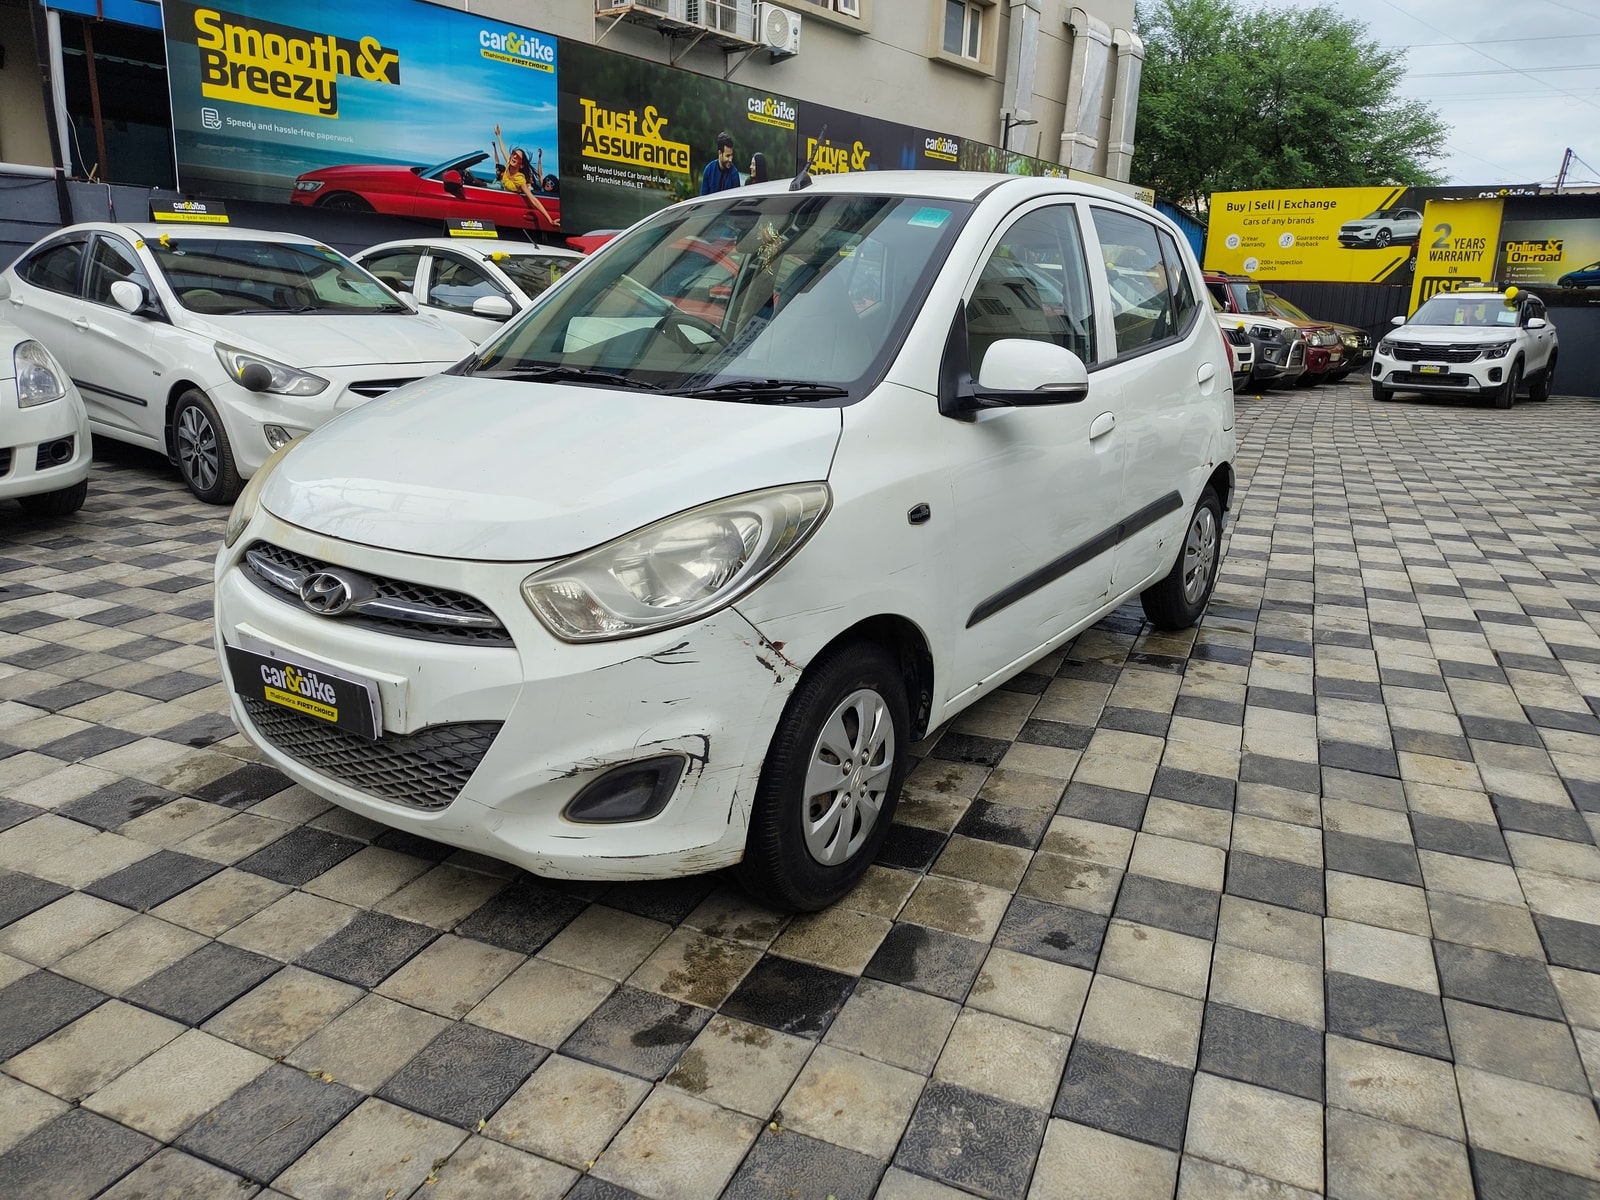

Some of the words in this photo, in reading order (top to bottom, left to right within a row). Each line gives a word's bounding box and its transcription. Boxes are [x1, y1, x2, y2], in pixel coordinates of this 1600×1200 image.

[194, 9, 351, 76] Smooth
[356, 36, 399, 84] &
[480, 30, 554, 62] car&bike
[512, 57, 528, 66] FIRST
[528, 62, 548, 71] CHOICE
[201, 49, 337, 115] Breezy
[580, 98, 637, 134] Trust
[642, 105, 668, 140] &
[748, 98, 795, 120] car&bike
[226, 117, 256, 130] Speedy
[257, 122, 273, 132] and
[274, 124, 315, 138] hassle-free
[316, 133, 354, 144] paperwork
[582, 126, 688, 169] Assurance
[807, 137, 848, 164] Drive
[851, 141, 871, 170] &
[925, 137, 957, 155] car&bike
[582, 163, 597, 173] Most
[597, 166, 612, 175] loved
[613, 169, 626, 177] Used
[627, 171, 636, 179] Car
[636, 173, 652, 182] brand
[658, 176, 671, 184] India
[586, 173, 594, 183] By
[595, 175, 620, 186] Franchise
[1226, 202, 1246, 212] Buy
[1254, 200, 1275, 210] Sell
[1284, 199, 1337, 210] Exchange
[1261, 217, 1271, 225] of
[1272, 218, 1286, 226] any
[1431, 223, 1452, 249] 2
[1454, 238, 1486, 249] YEARS
[1506, 241, 1542, 252] Online
[1545, 237, 1563, 252] &
[1429, 250, 1484, 262] WARRANTY
[1511, 251, 1562, 262] On-road
[1448, 266, 1458, 274] ON
[260, 664, 336, 705] car&bike
[297, 700, 313, 711] FIRST
[314, 706, 335, 718] CHOICE
